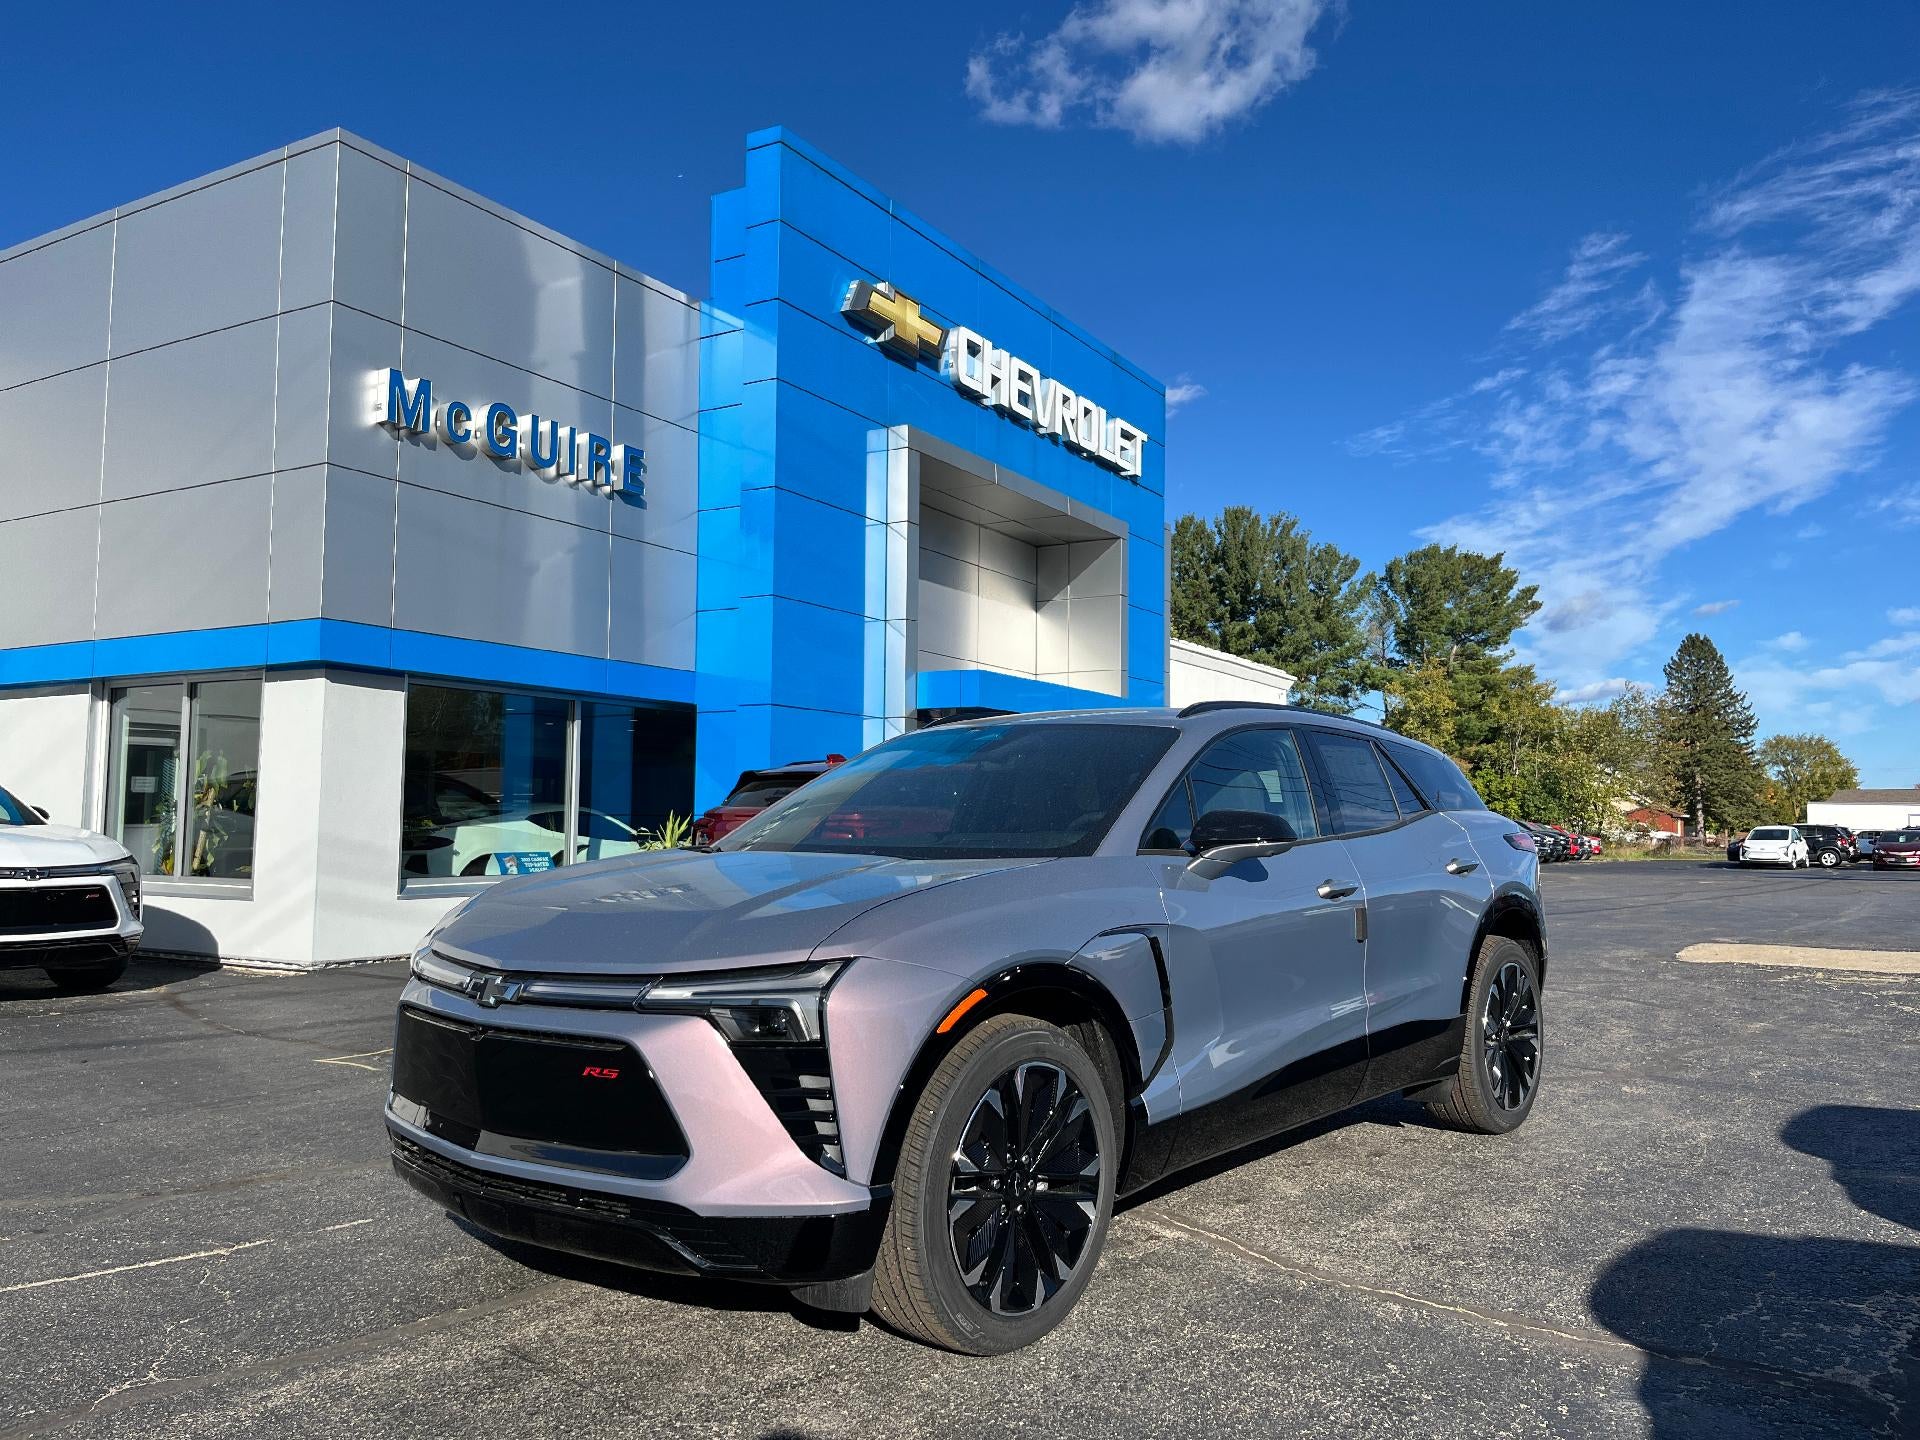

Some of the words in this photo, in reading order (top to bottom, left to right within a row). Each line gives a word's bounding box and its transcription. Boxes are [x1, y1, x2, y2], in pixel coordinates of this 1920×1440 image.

[386, 367, 646, 496] McGUIRE
[950, 326, 1148, 478] CHEVROLET
[582, 1066, 620, 1079] RS
